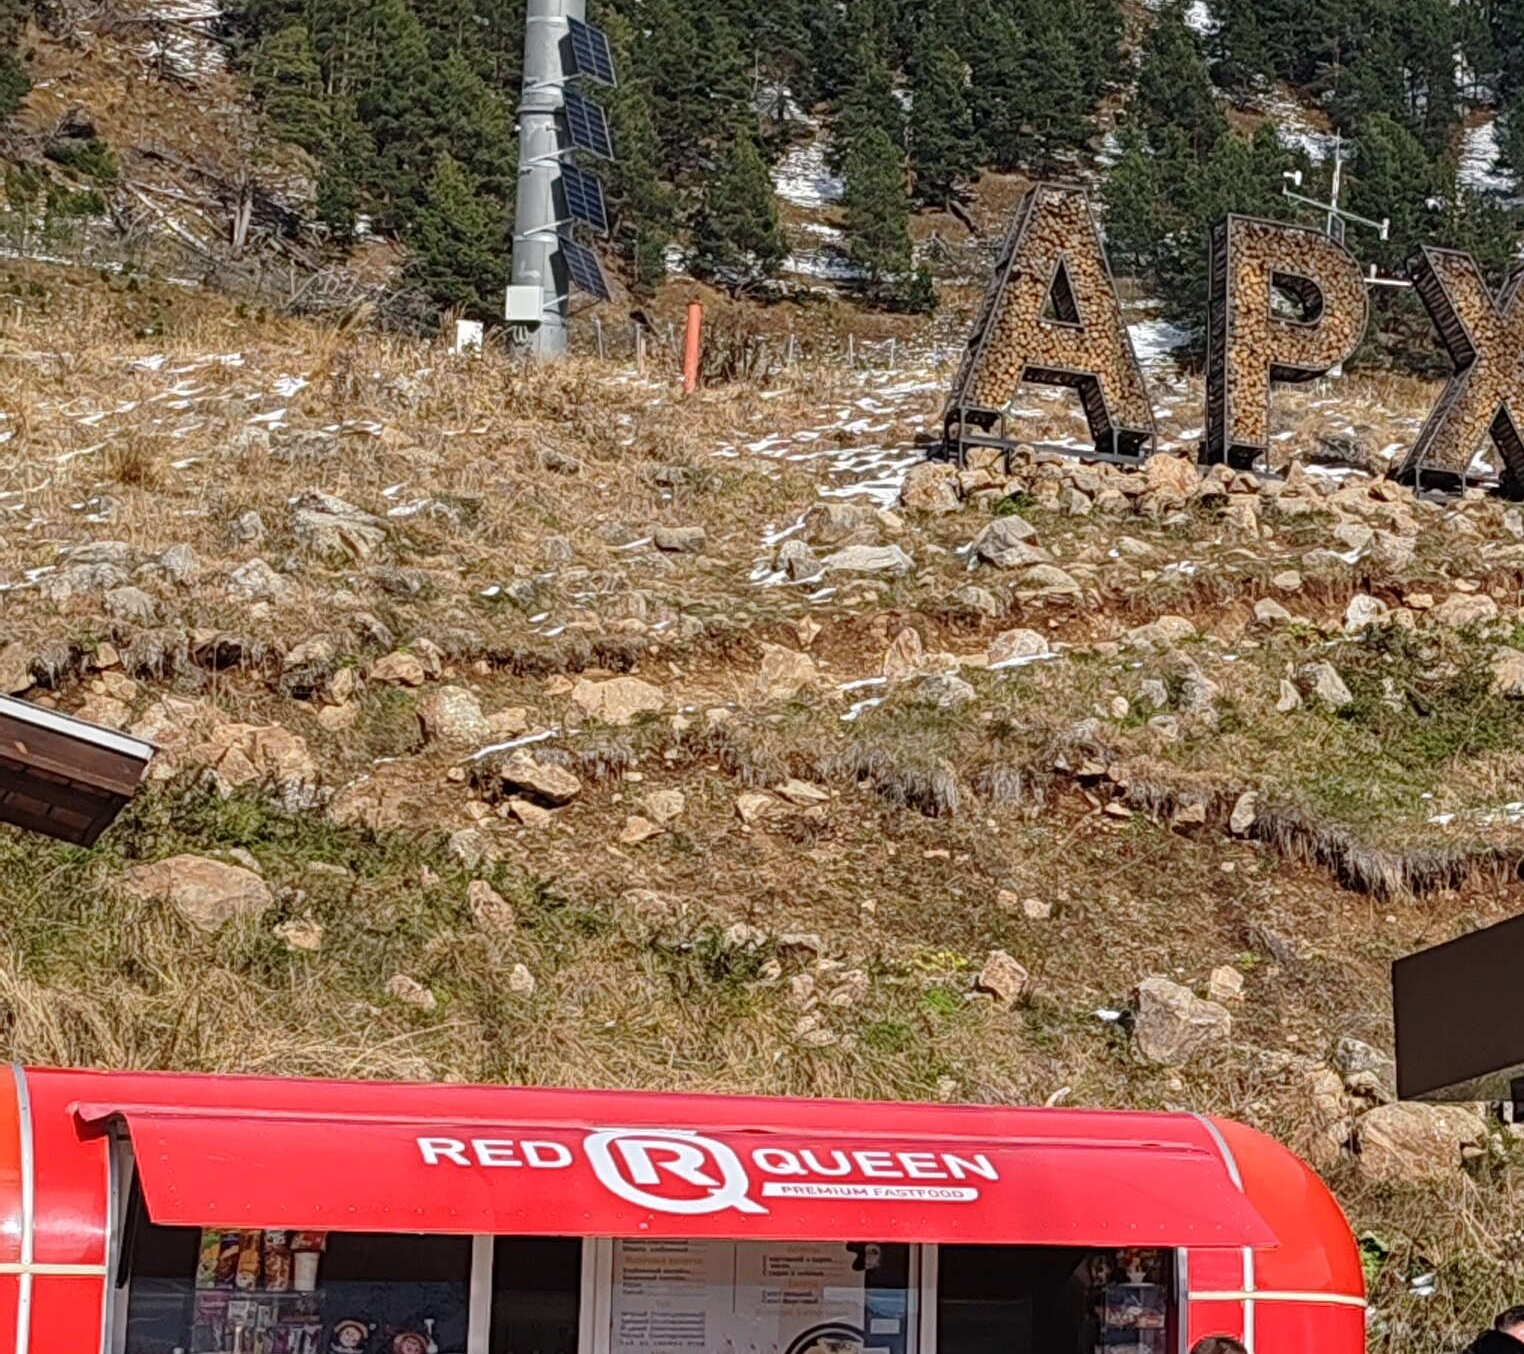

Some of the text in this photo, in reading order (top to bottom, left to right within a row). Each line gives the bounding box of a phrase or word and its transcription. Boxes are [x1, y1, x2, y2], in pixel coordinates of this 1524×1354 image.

[416, 1137, 573, 1168] RED
[751, 1146, 999, 1181] QUEEN
[780, 1185, 965, 1199] PREMIUM FASTFOOD
